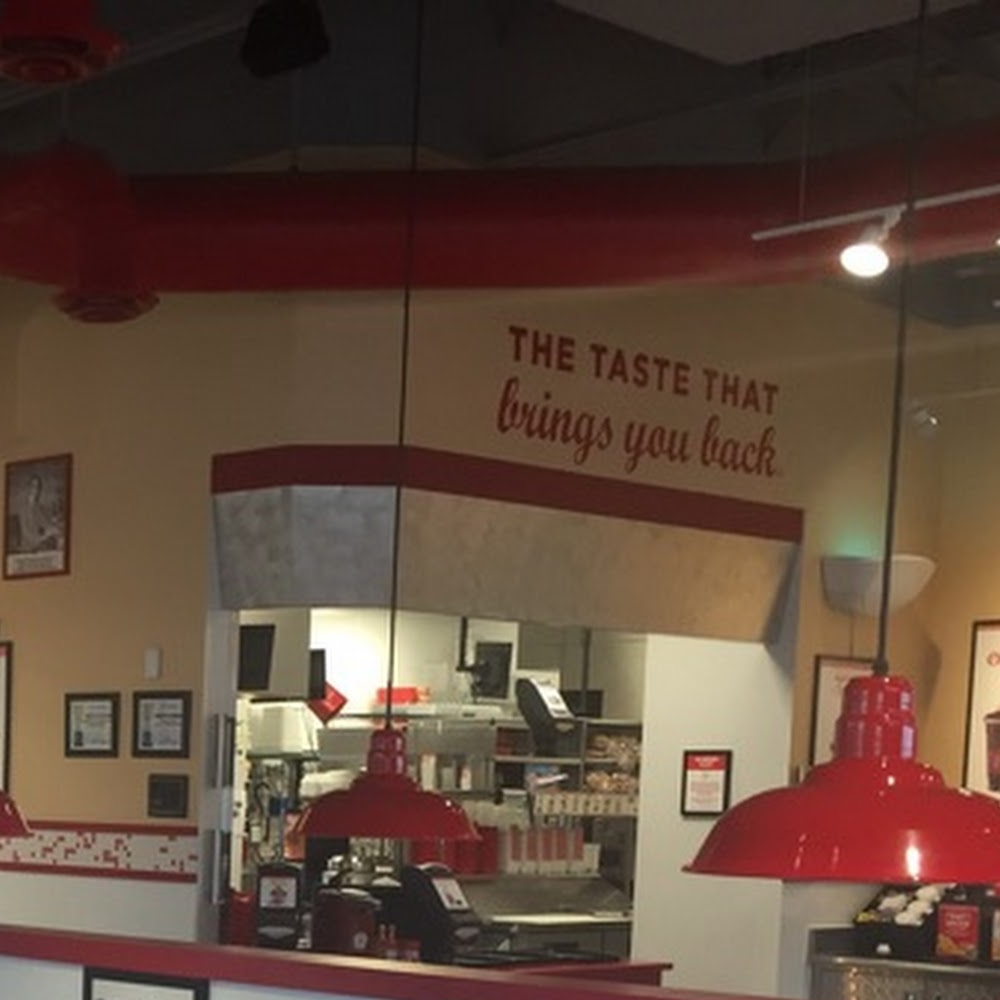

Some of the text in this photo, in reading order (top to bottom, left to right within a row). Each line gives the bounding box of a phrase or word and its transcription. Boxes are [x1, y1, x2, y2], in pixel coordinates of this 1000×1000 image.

[508, 325, 780, 415] THE TASTE THAT
[496, 376, 777, 477] brings you back
